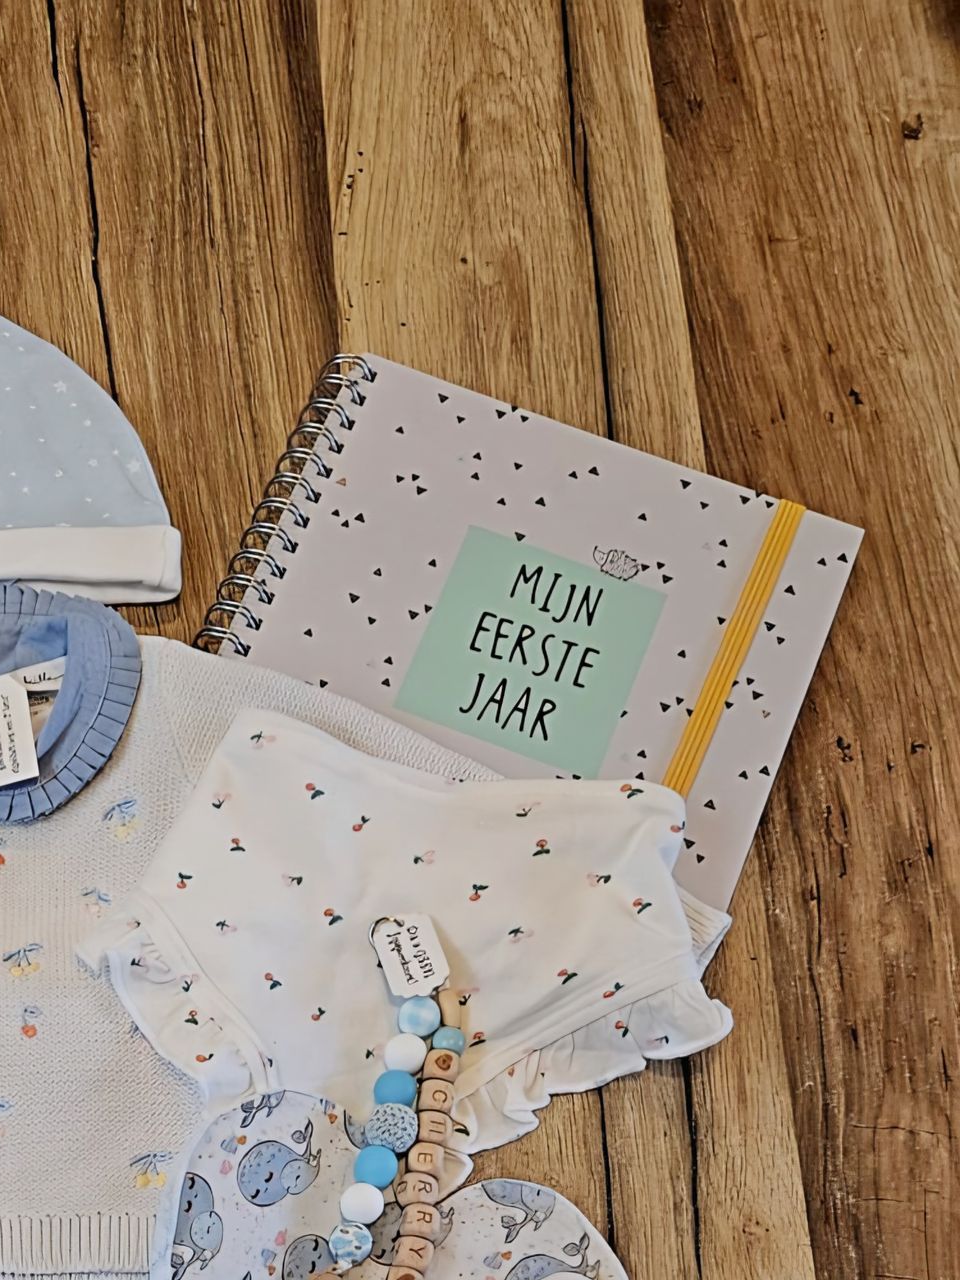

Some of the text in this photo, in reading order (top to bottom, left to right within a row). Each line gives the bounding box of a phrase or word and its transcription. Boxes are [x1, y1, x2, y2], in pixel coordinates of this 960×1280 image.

[510, 563, 604, 627] MIJN
[469, 611, 600, 689] EERSTE
[458, 673, 557, 742] JAAR
